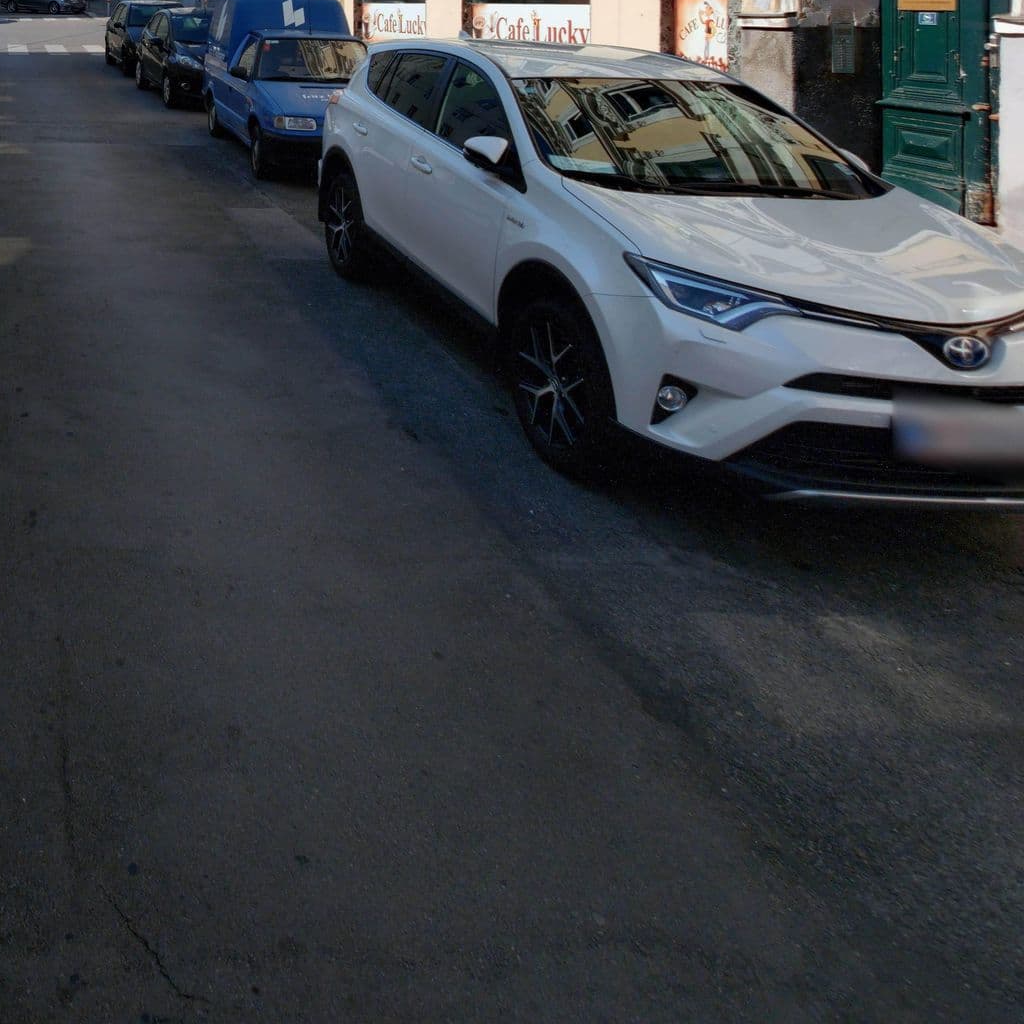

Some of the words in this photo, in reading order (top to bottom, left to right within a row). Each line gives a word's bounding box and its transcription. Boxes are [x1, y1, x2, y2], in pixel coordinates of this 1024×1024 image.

[376, 12, 397, 34] Cafe
[495, 17, 530, 41] Cafe
[533, 18, 591, 44] Lucky
[679, 17, 697, 41] CAFE
